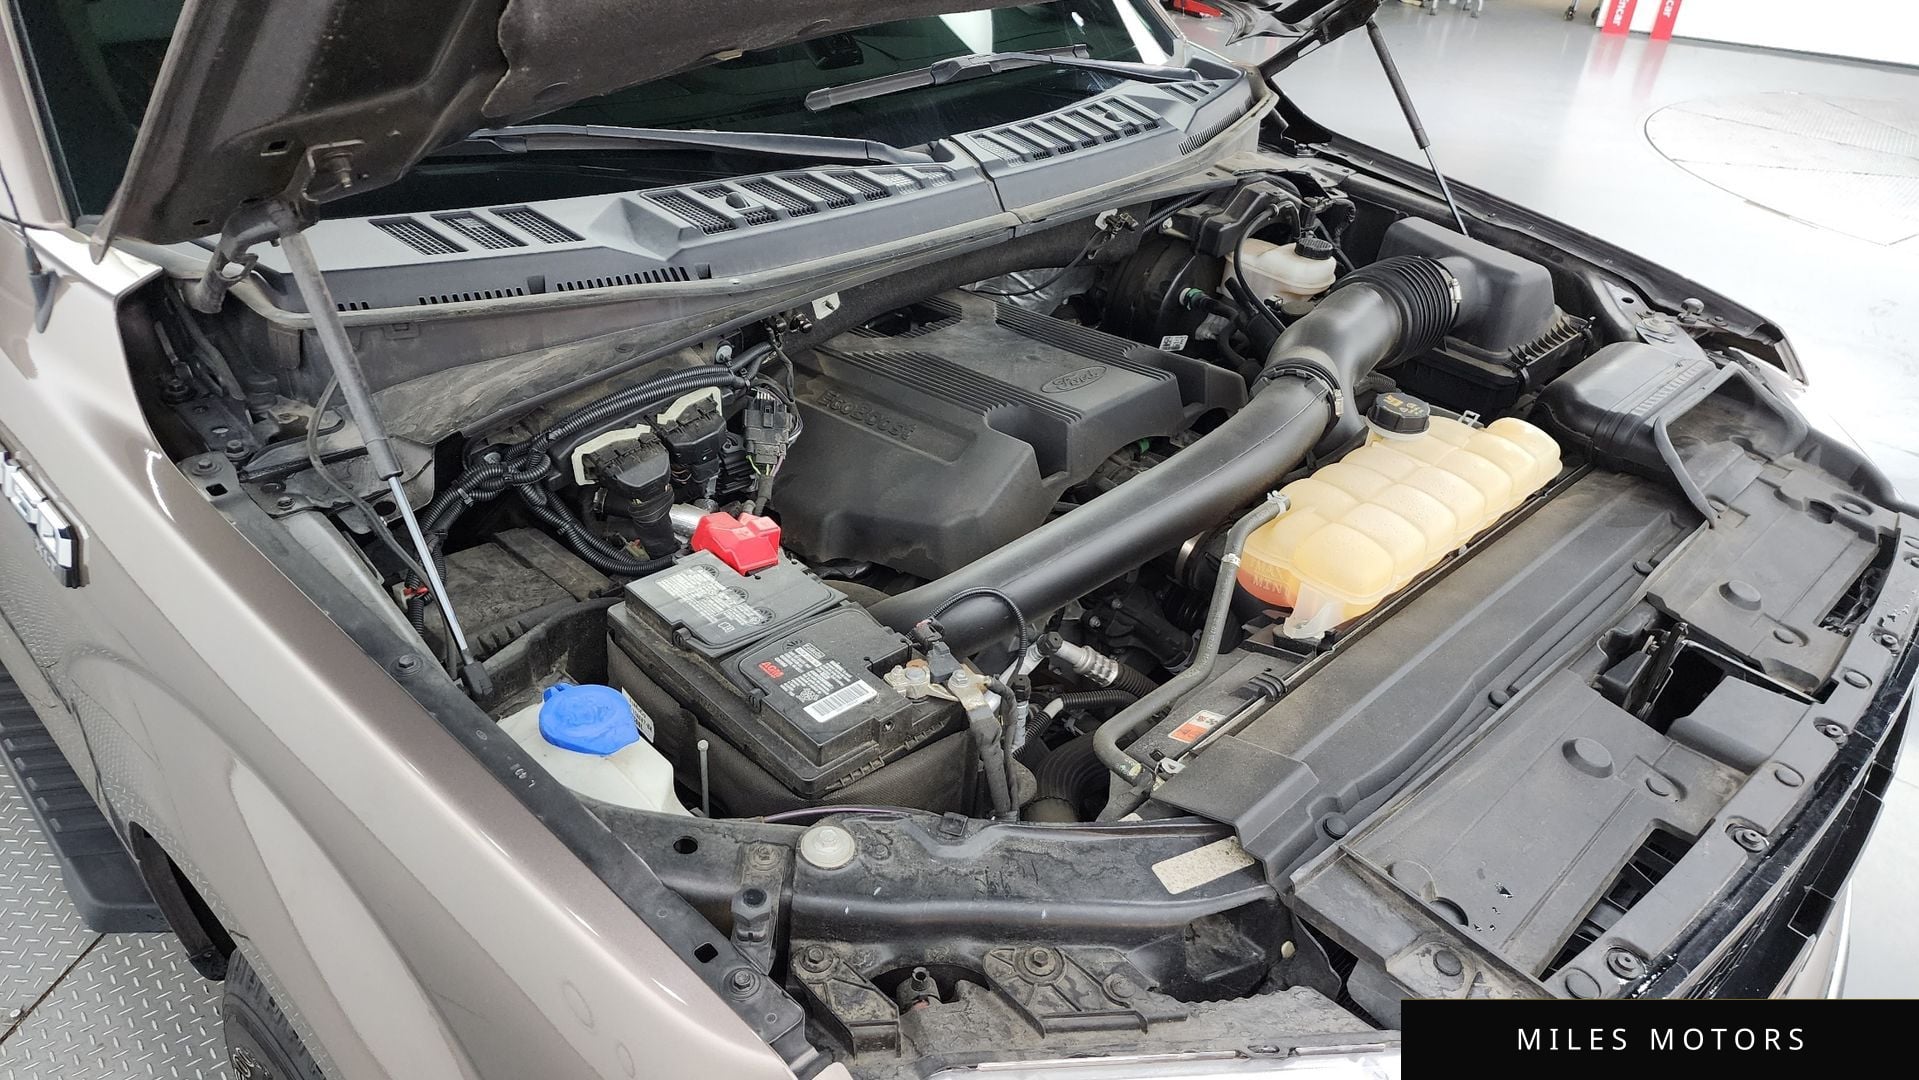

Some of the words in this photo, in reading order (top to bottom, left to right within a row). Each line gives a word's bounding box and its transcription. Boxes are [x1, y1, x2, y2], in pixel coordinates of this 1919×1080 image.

[1612, 0, 1630, 26] ncar
[1662, 0, 1675, 18] car
[1051, 369, 1099, 391] Ford
[1251, 574, 1283, 595] MIN
